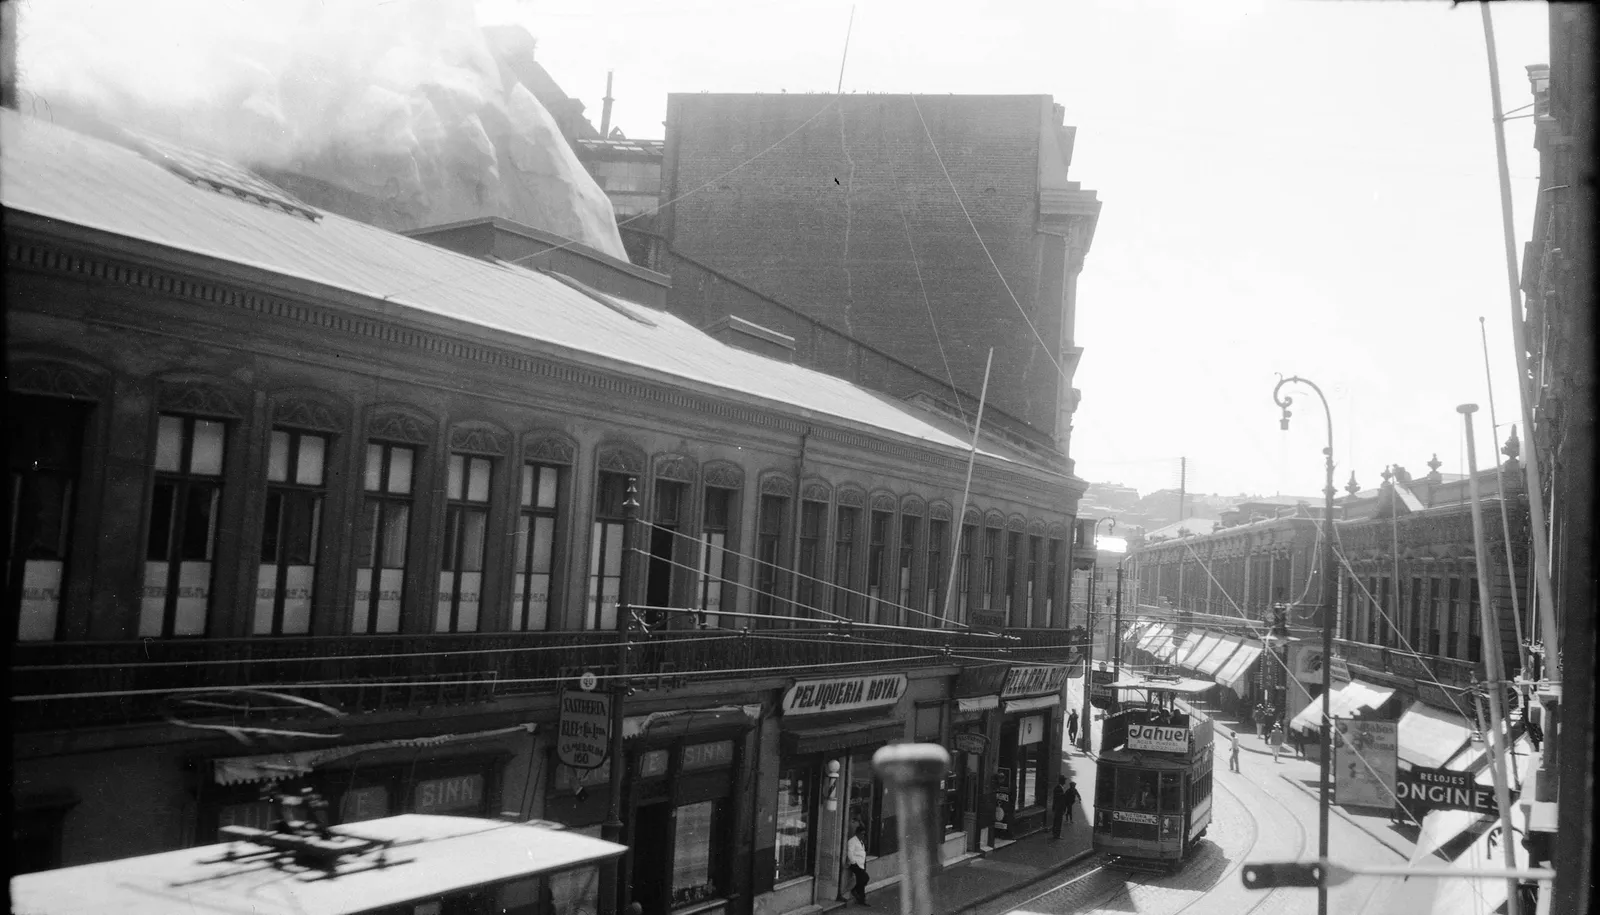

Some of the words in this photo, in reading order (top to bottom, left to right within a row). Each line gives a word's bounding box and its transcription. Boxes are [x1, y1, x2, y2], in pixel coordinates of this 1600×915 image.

[1004, 668, 1049, 694] RELOJERIA
[790, 680, 864, 709] PELUQUERIA
[866, 677, 901, 701] ROYAL
[1129, 725, 1188, 742] Jahuel
[1420, 773, 1465, 785] RELOJES
[1396, 782, 1500, 811] ONGINES
[1113, 811, 1120, 820] 3
[1151, 815, 1159, 824] 3
